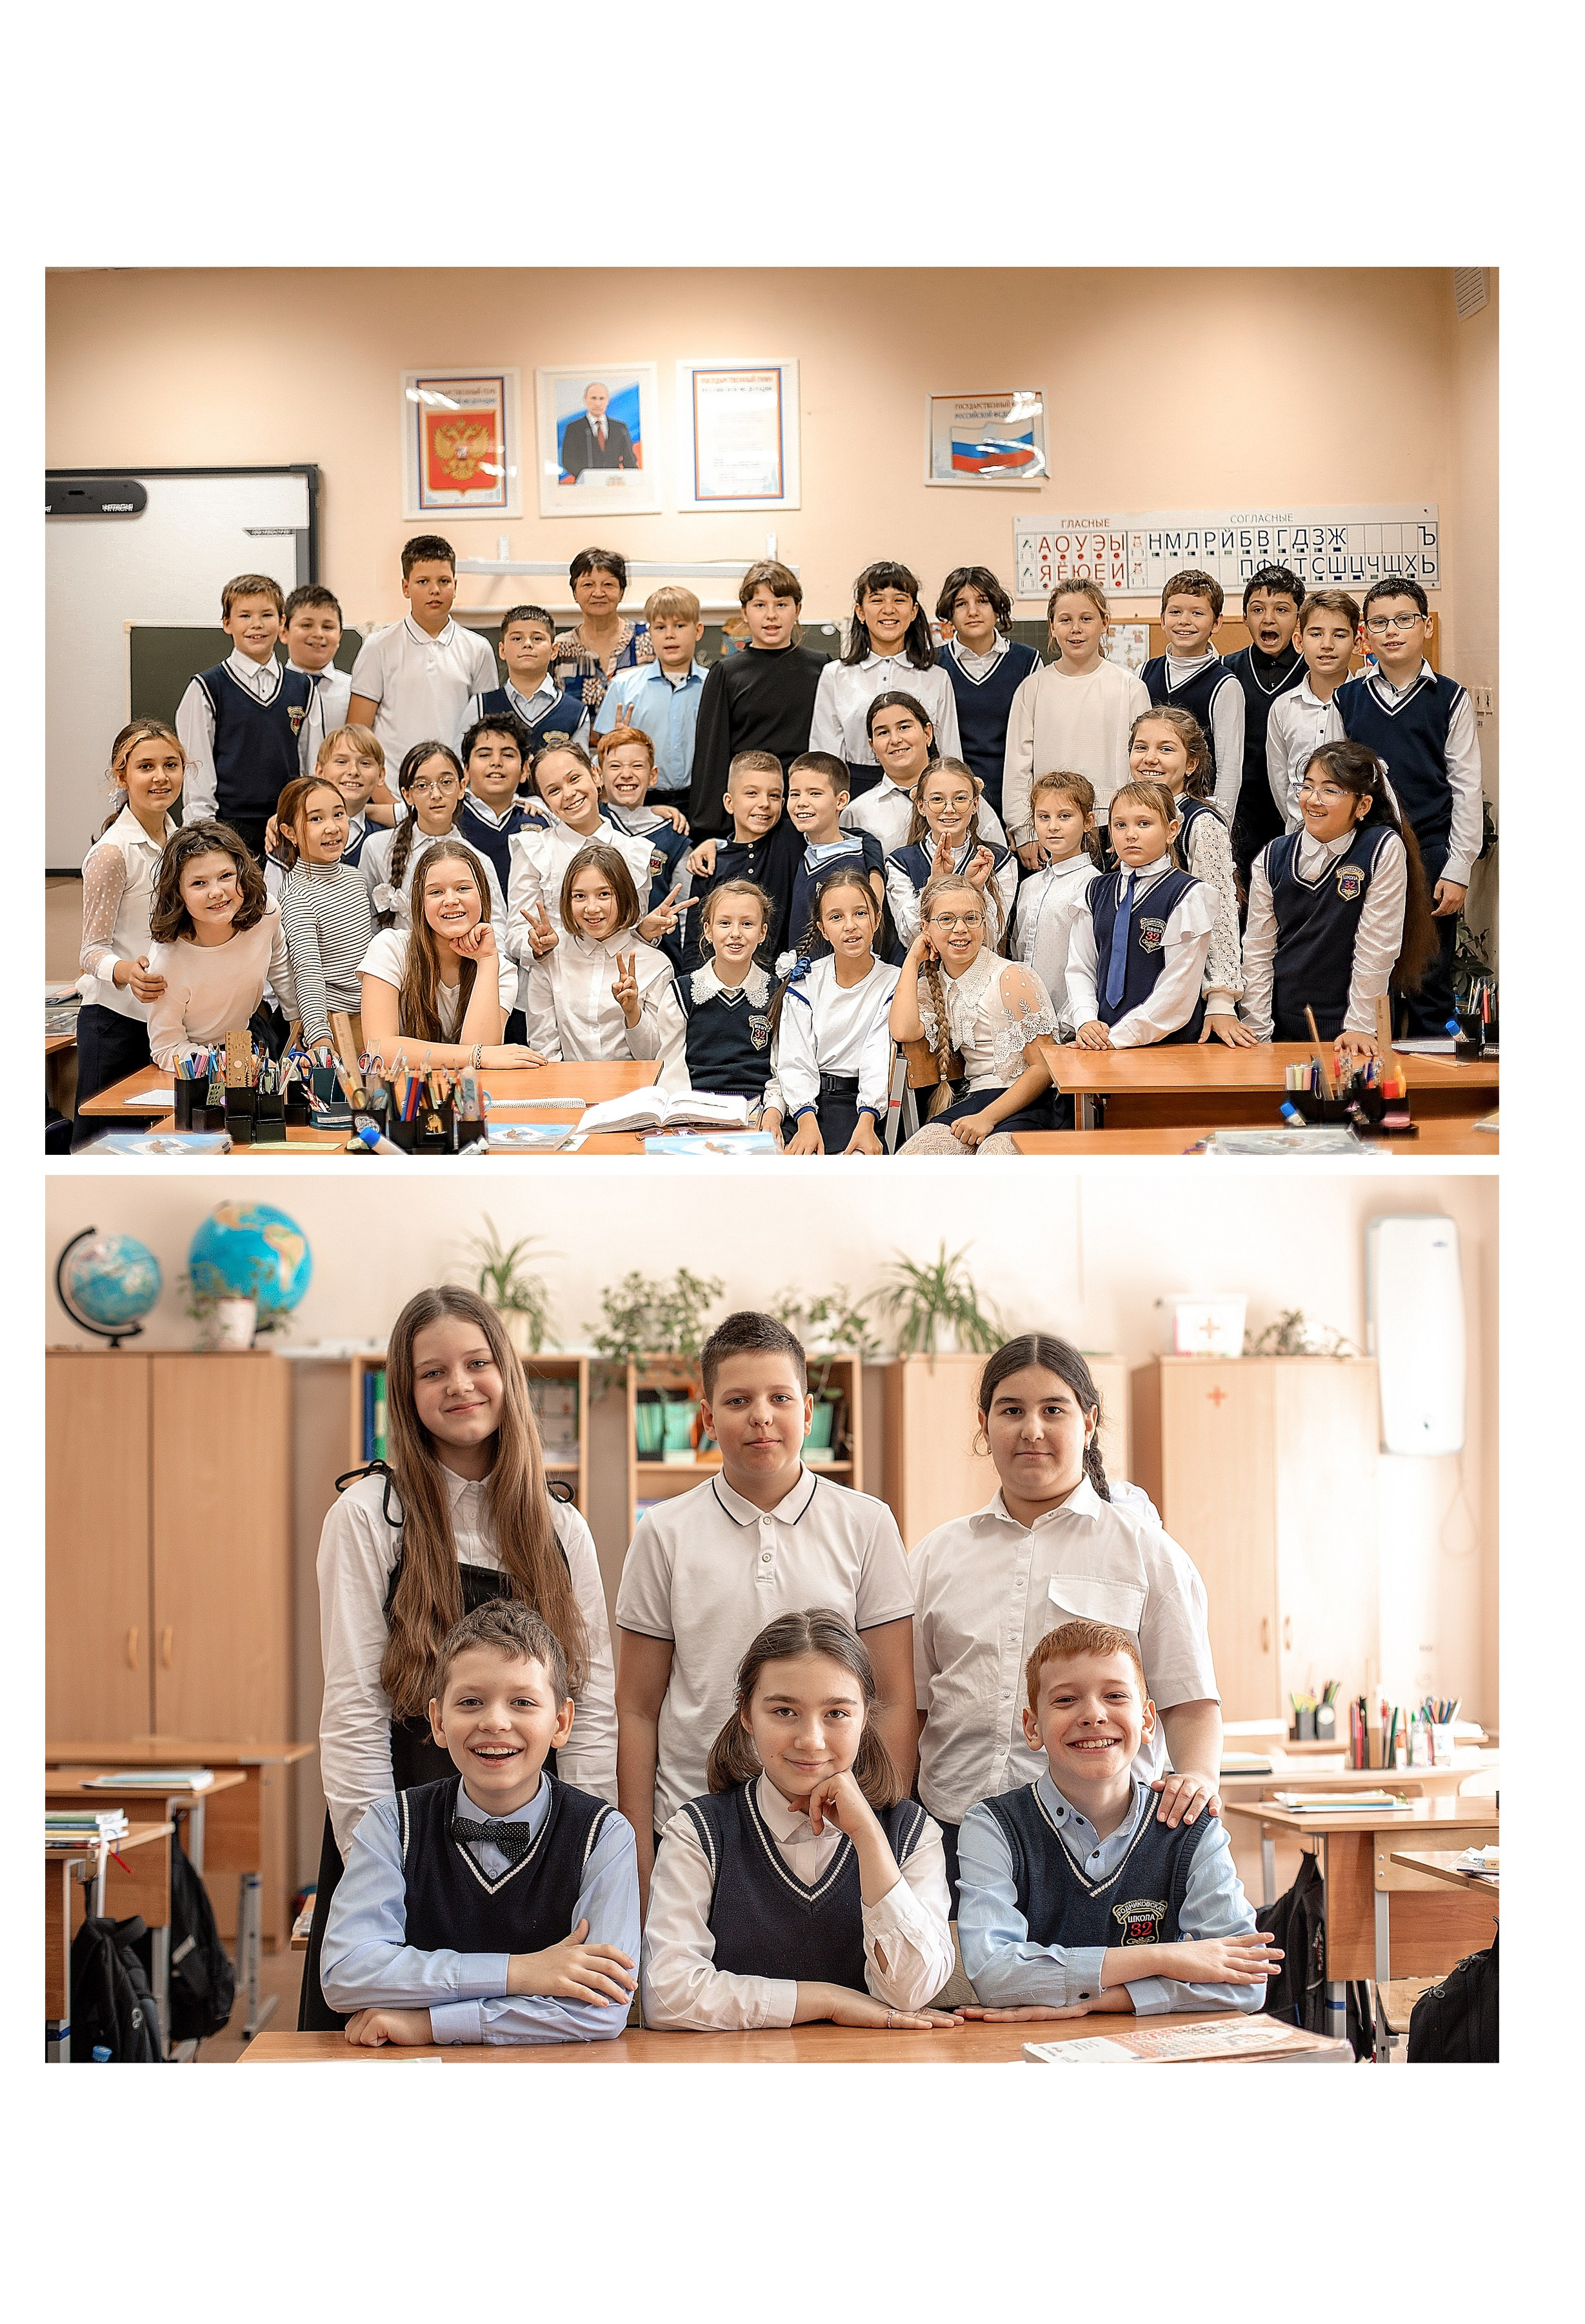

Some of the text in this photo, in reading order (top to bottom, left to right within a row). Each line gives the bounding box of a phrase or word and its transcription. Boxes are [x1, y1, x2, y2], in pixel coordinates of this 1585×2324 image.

[1061, 518, 1110, 528] ГЛАСНЫЕ
[1230, 513, 1293, 523] СОГЛАСНЫЕ
[1039, 534, 1124, 553] А О У Э Ы
[1149, 526, 1436, 550] Н М Л Р Й Б В Г Д З Ж Ъ
[1241, 559, 1253, 576] П
[1294, 557, 1308, 574] Т
[1311, 557, 1325, 574] С
[1328, 556, 1346, 574] Ш
[1350, 556, 1364, 576] Ц
[1367, 556, 1379, 572] Ч
[1383, 555, 1402, 576] Щ
[1404, 555, 1417, 572] Х
[1422, 554, 1435, 574] Ь
[1040, 565, 1052, 581] Я
[1095, 563, 1106, 580] Е
[1112, 563, 1124, 580] И
[650, 859, 660, 868] 32
[1344, 880, 1355, 890] 32
[1145, 932, 1160, 941] 32
[755, 1028, 766, 1039] 32
[1117, 1901, 1165, 1917] РОДНИКОВСКАЯ
[1128, 1914, 1156, 1923] ШКОЛА
[1130, 1921, 1153, 1937] 32
